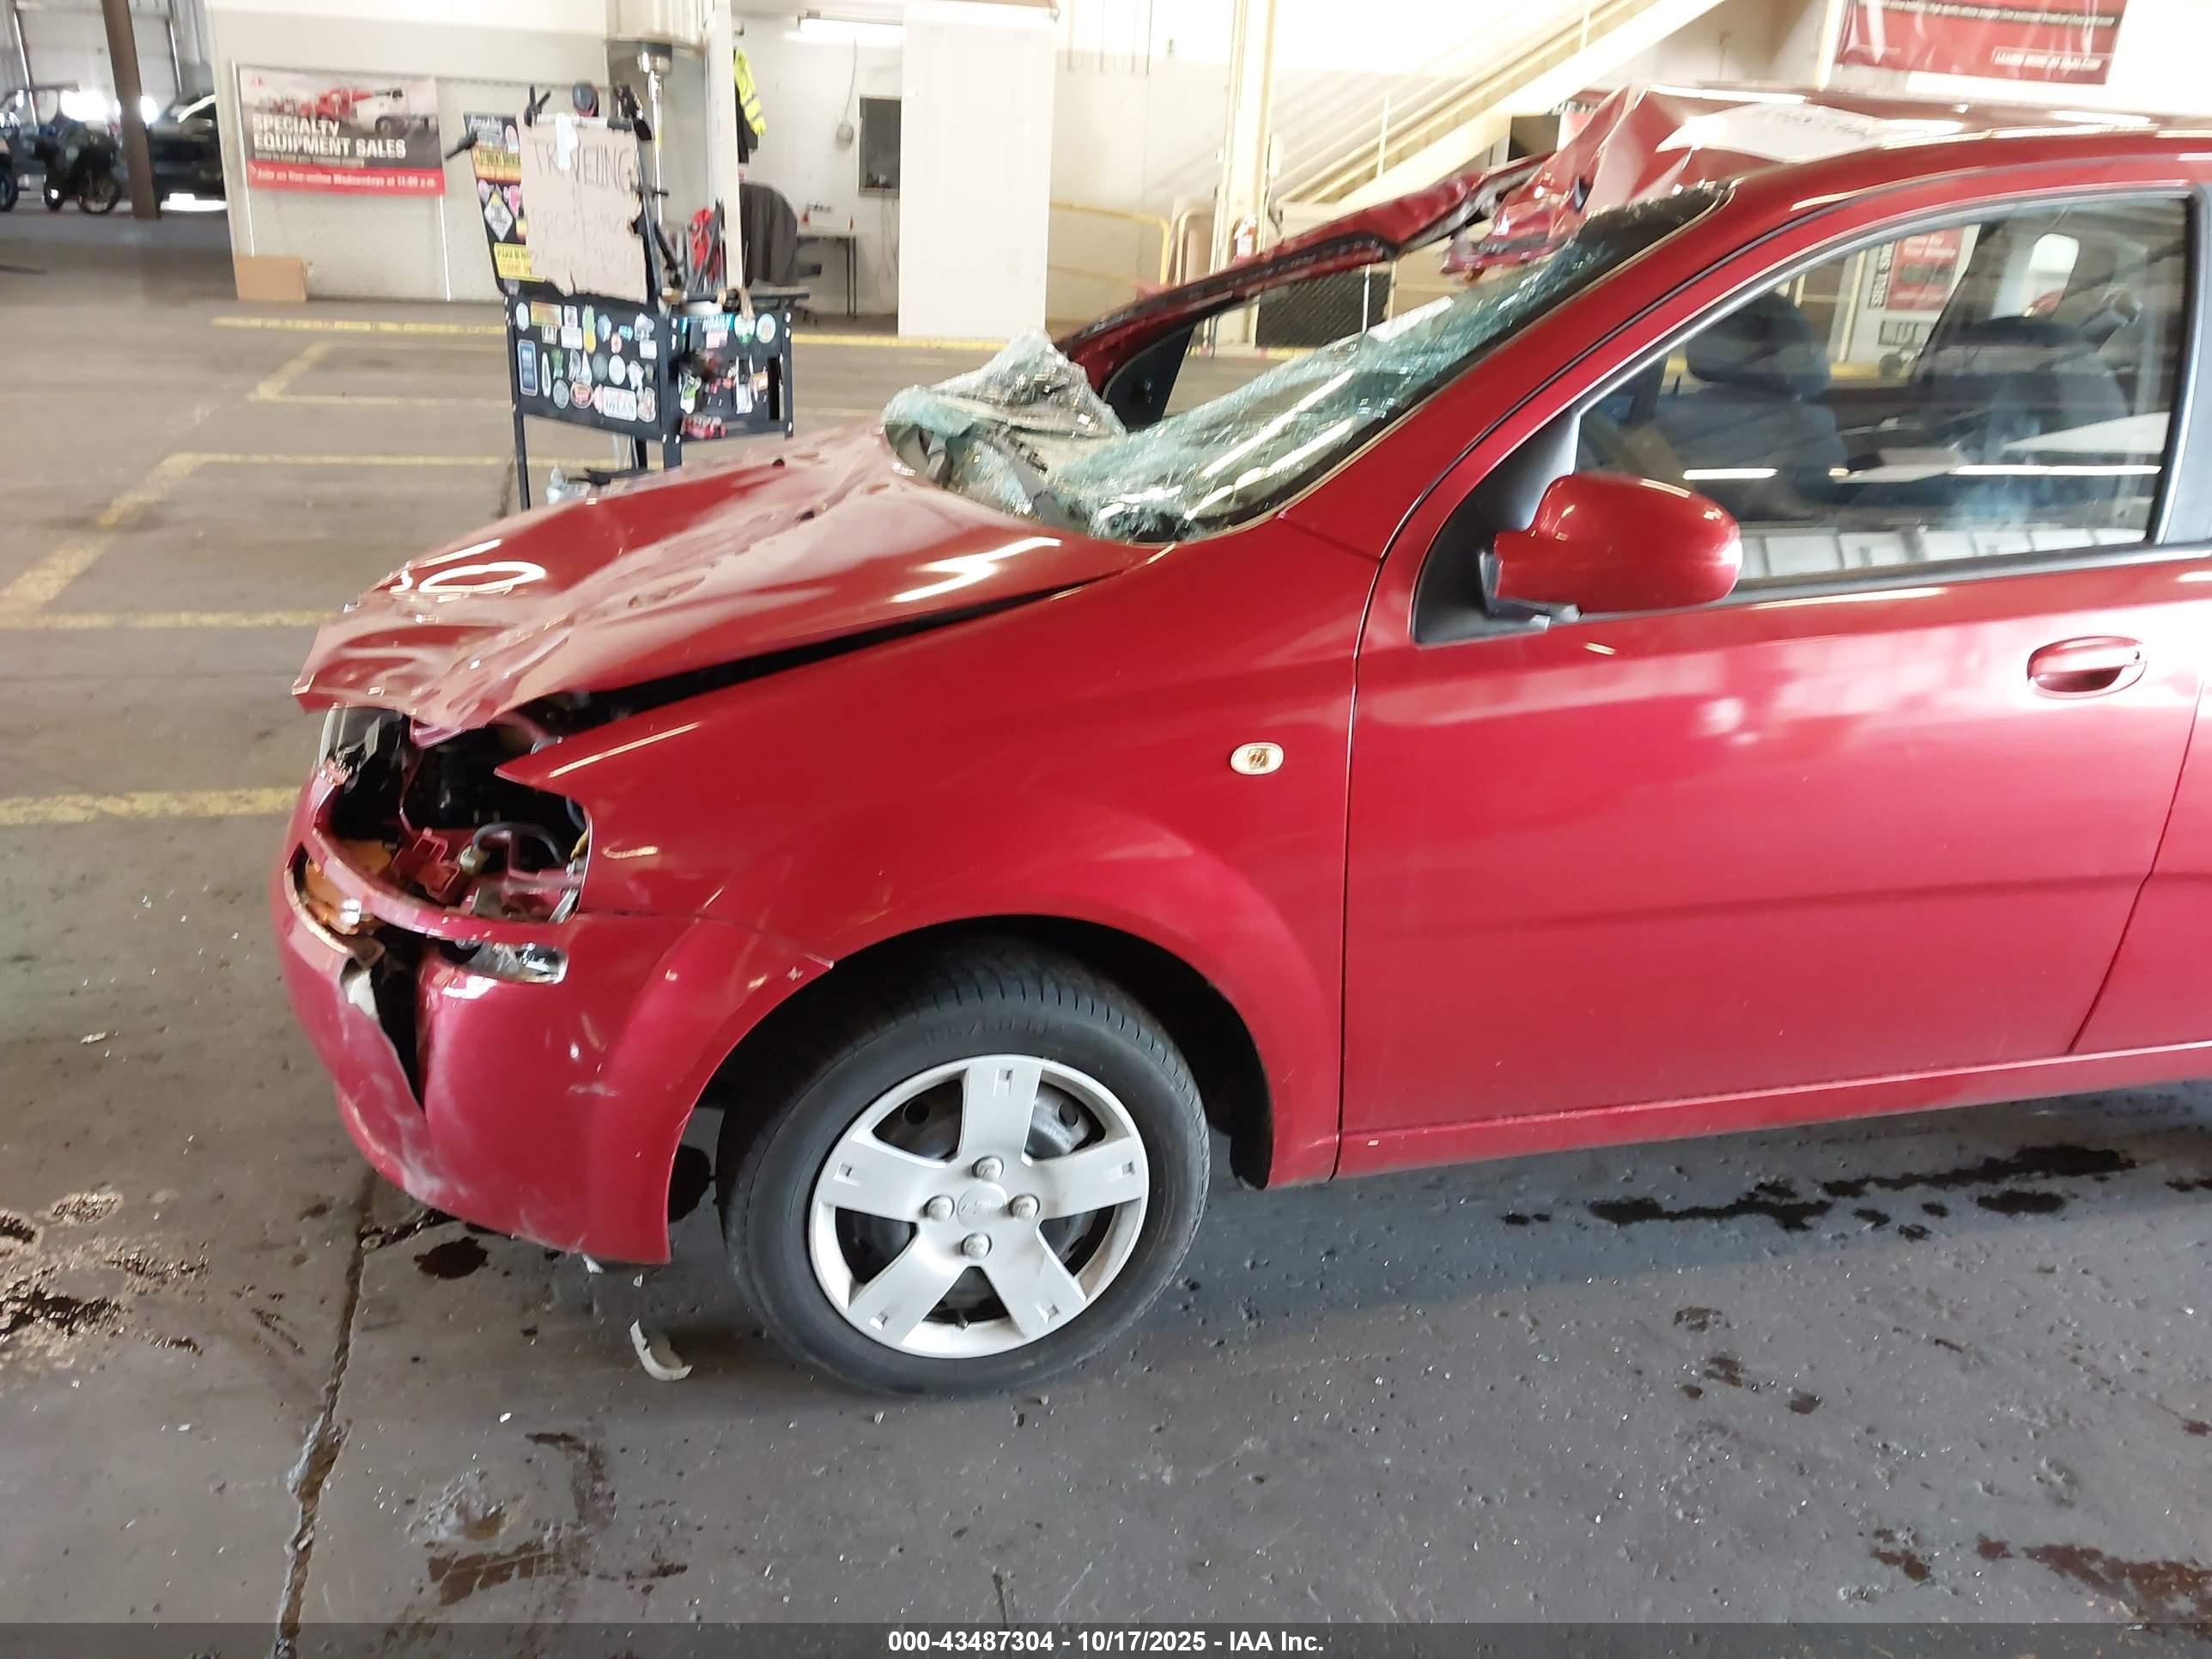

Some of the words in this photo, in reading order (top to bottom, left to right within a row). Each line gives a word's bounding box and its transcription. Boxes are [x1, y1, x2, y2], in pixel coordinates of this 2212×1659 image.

[252, 113, 339, 135] SPECIALTY
[253, 131, 351, 157] EQUIPMENT
[356, 138, 407, 159] SALES
[333, 173, 386, 187] Wednesdays
